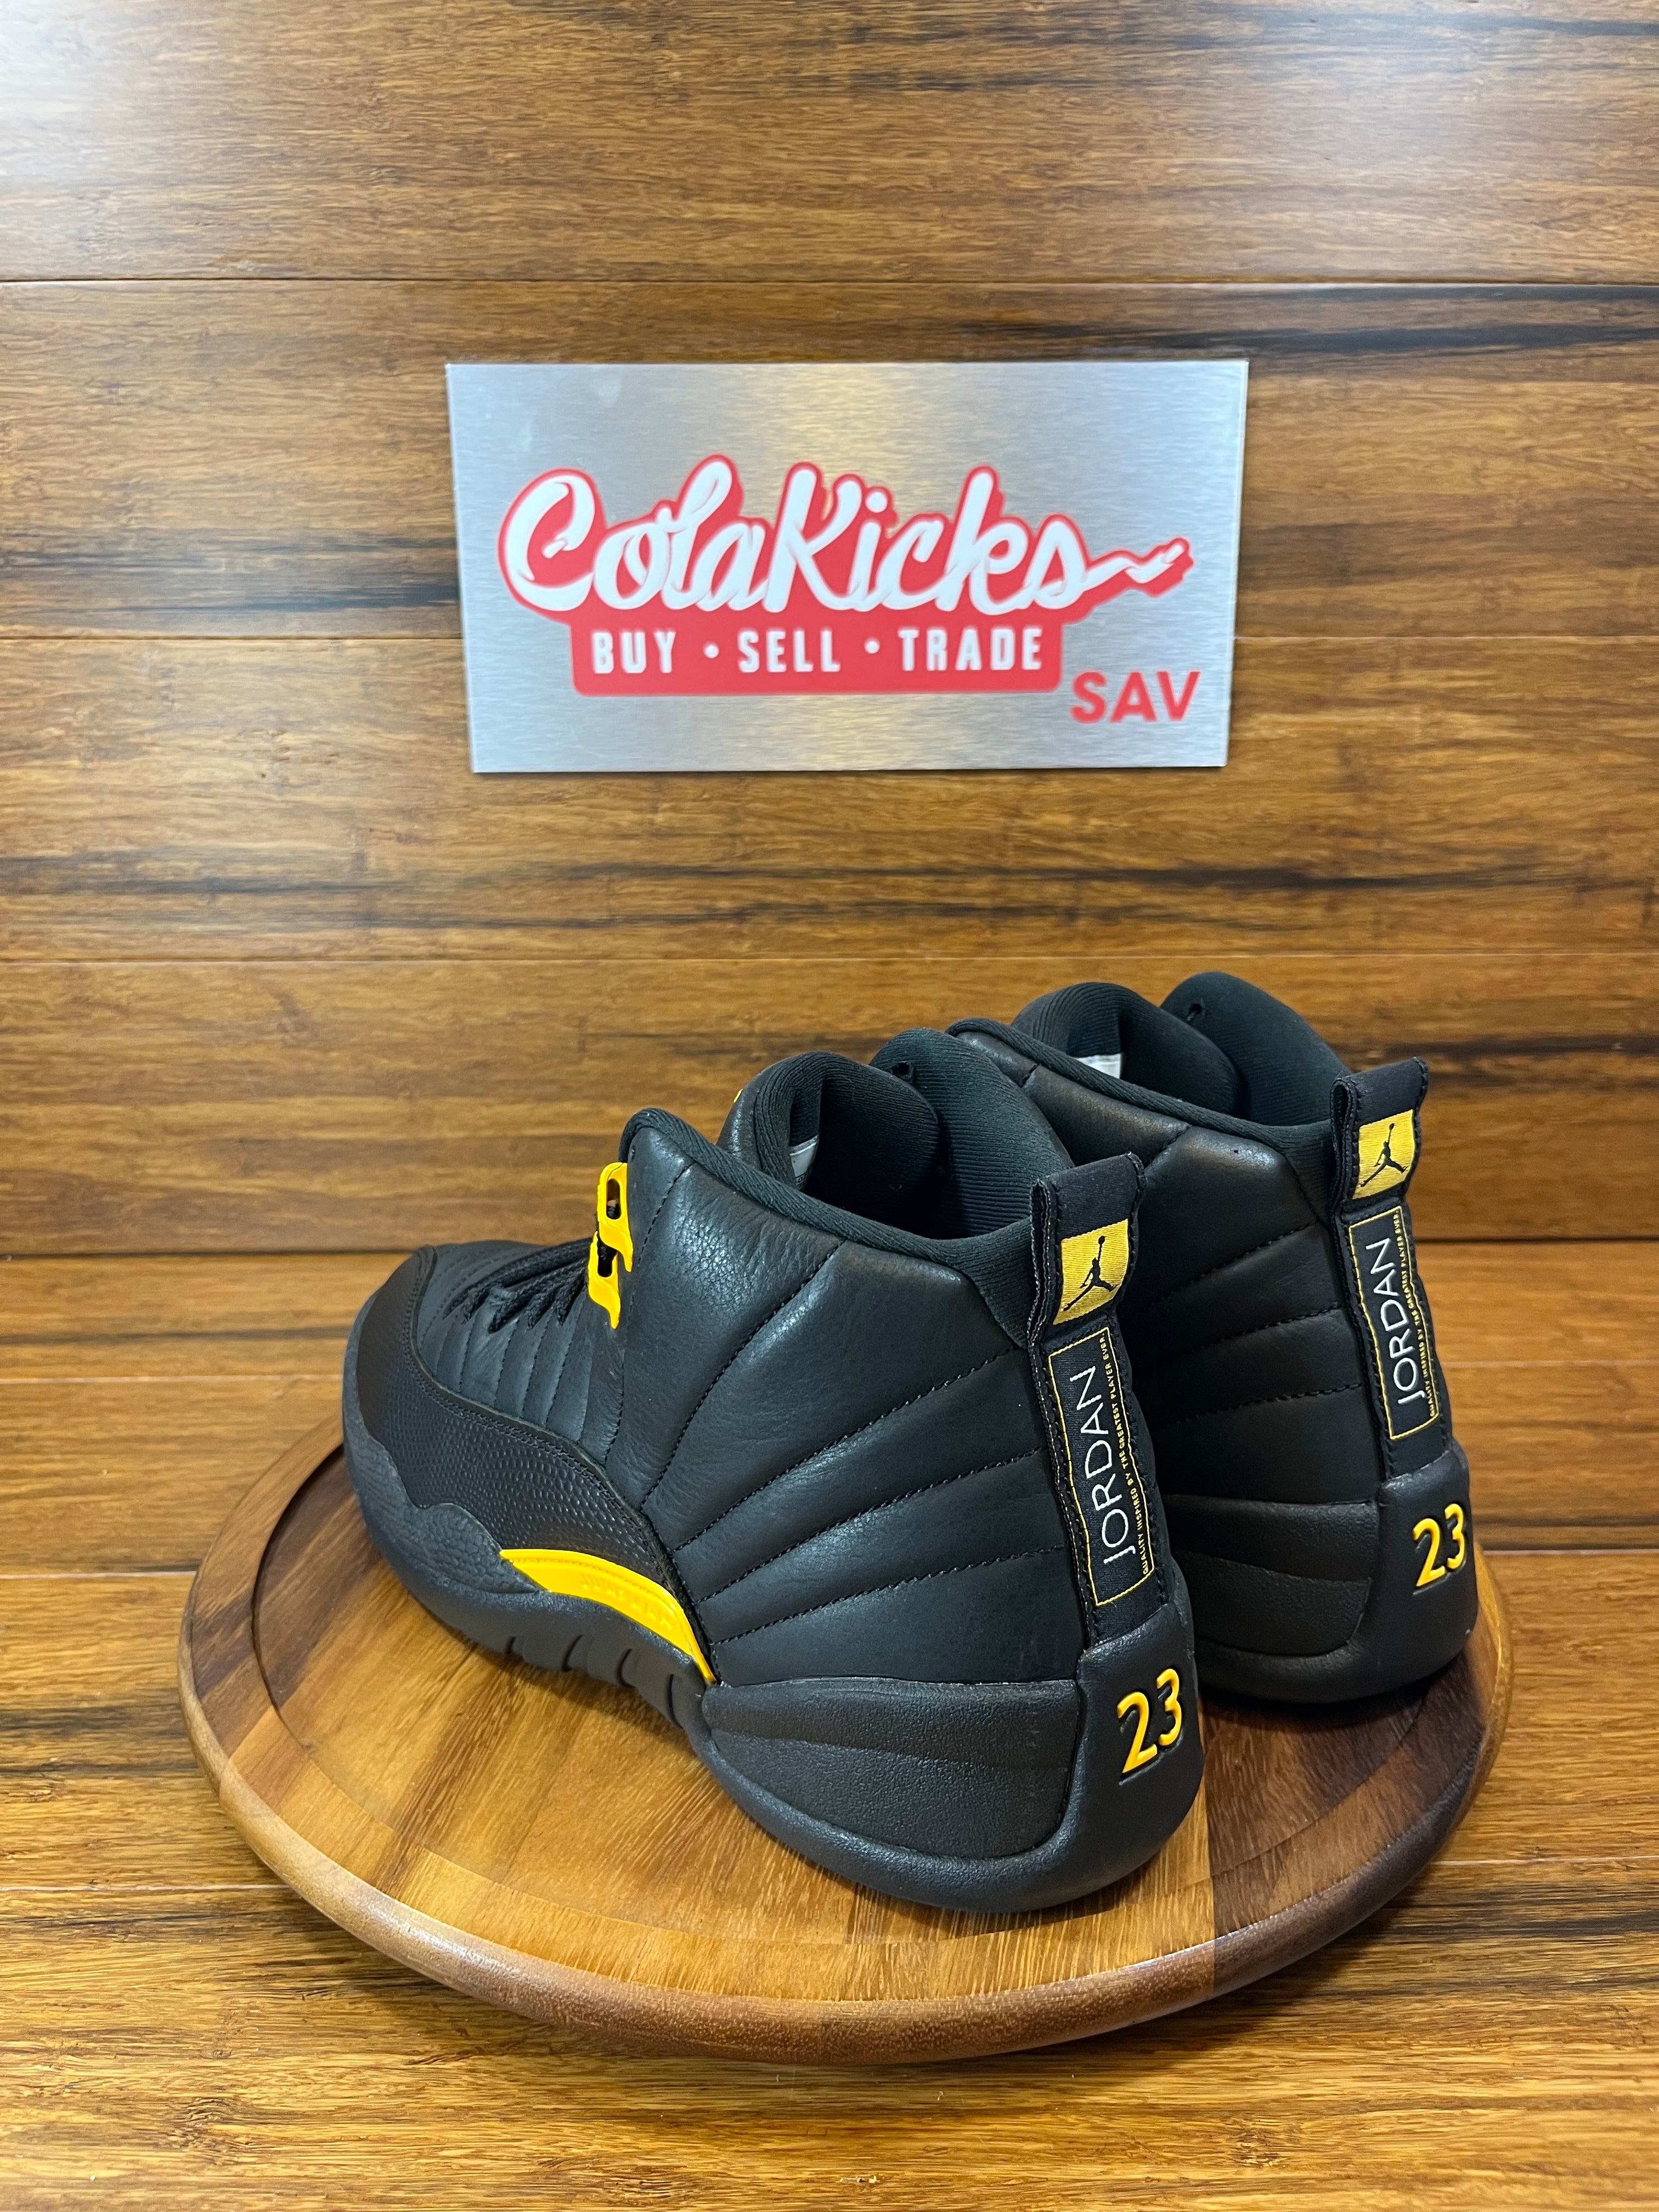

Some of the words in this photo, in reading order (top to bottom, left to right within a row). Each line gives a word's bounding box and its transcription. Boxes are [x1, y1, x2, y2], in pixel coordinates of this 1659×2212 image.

[504, 459, 1186, 616] ColaKicks
[592, 630, 677, 675] BUY
[738, 628, 841, 674] SELL
[899, 627, 1043, 672] TRADE
[1070, 670, 1201, 724] SAV
[1397, 1236, 1406, 1267] PLAYER
[1401, 1271, 1414, 1308] GREATEST
[1365, 1238, 1425, 1404] JORDAN
[1411, 1310, 1420, 1325] THE
[1417, 1329, 1423, 1340] BY
[1419, 1342, 1428, 1377] INSPIRED
[1105, 1363, 1116, 1399] PLAYER
[1425, 1380, 1435, 1417] QUALITY
[1112, 1403, 1125, 1448] GREATEST
[1069, 1365, 1136, 1564] JORDAN
[1119, 1451, 1128, 1469] THE
[1126, 1472, 1133, 1486] BY
[1130, 1488, 1143, 1530] INSPIRED
[1138, 1533, 1149, 1575] QUALITY
[1412, 1503, 1465, 1587] 23
[1117, 1668, 1182, 1773] 23
